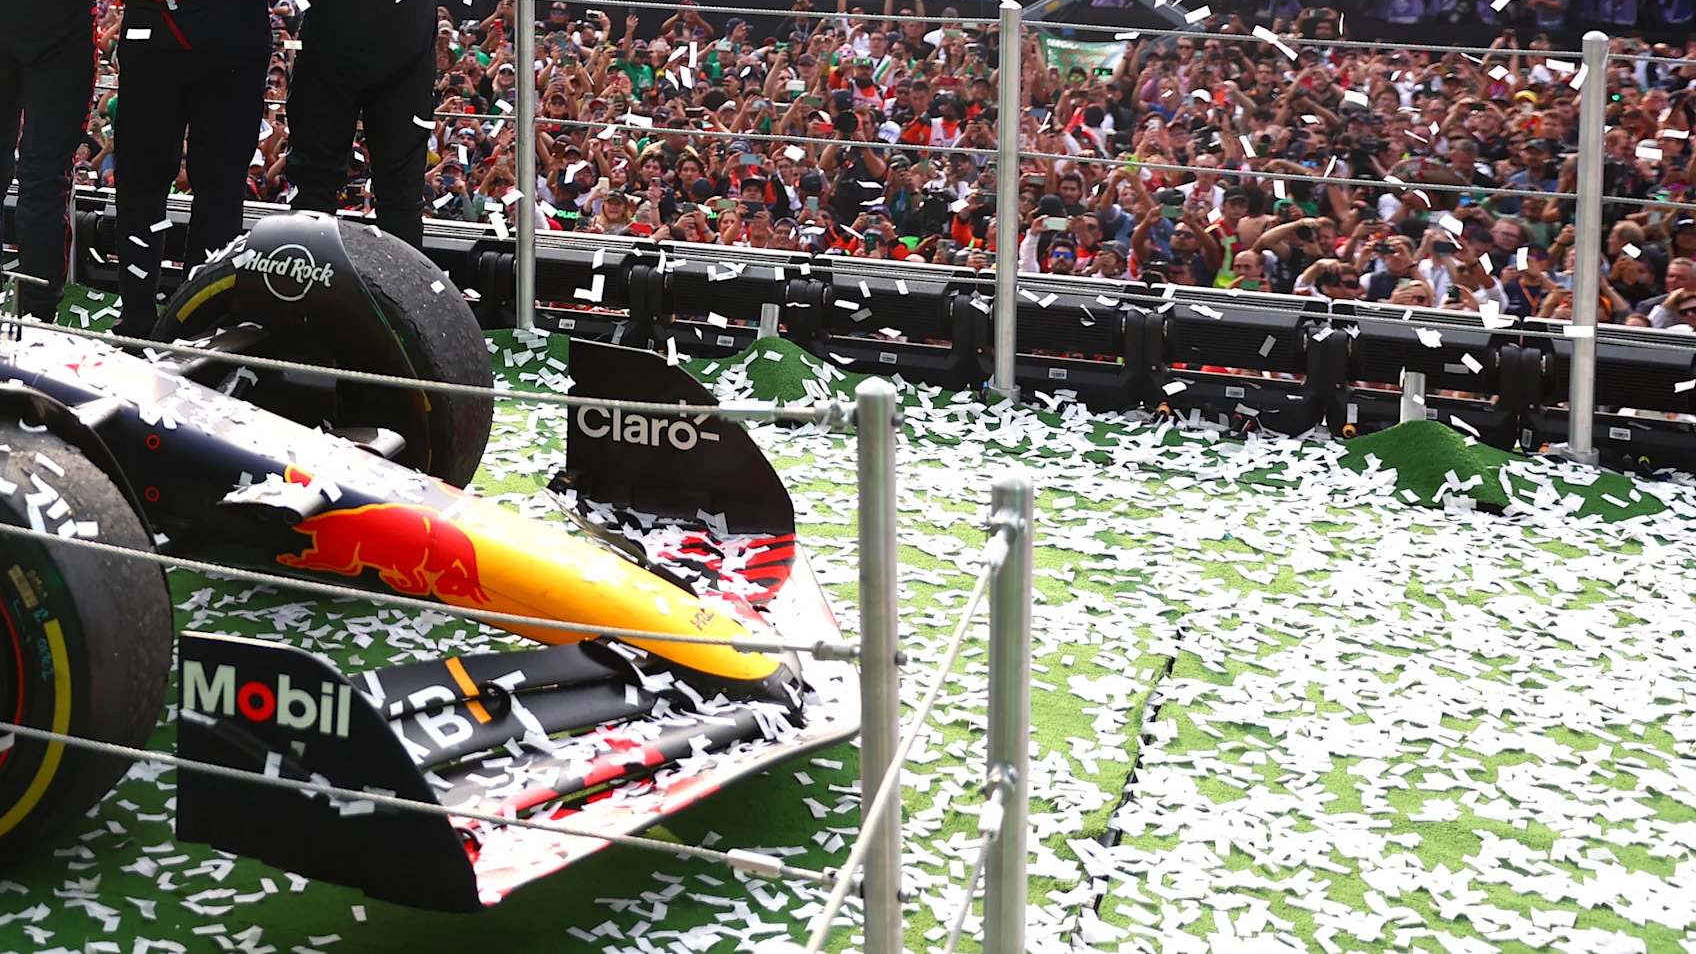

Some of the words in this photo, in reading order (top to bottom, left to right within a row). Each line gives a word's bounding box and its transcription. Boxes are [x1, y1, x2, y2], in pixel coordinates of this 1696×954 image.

[245, 252, 294, 280] Hard
[288, 257, 335, 287] Rock
[575, 401, 699, 451] Claro
[182, 660, 352, 738] Mobil
